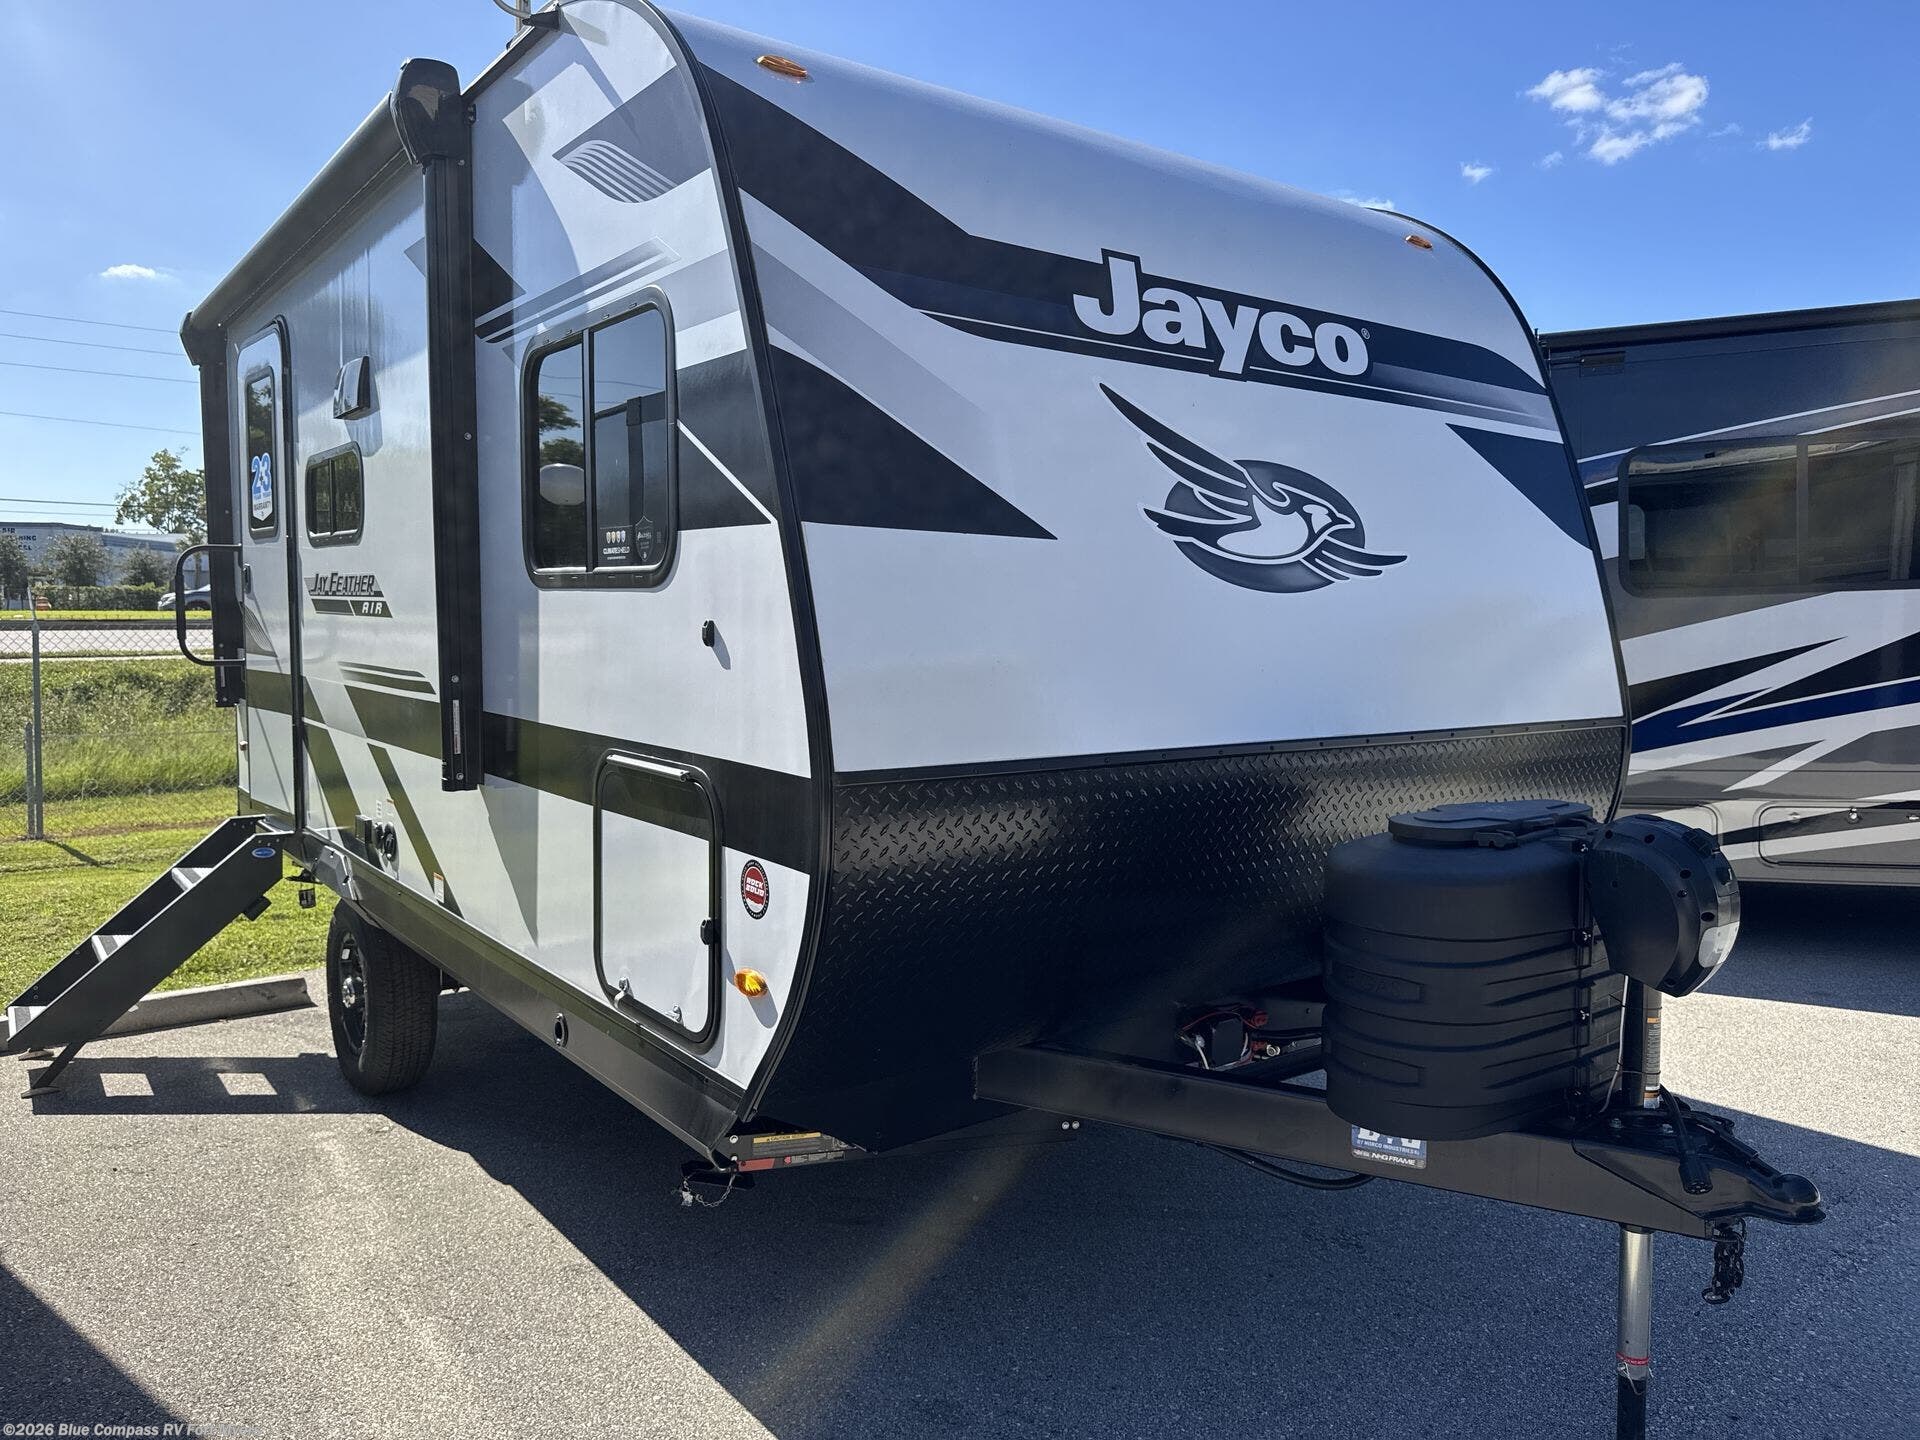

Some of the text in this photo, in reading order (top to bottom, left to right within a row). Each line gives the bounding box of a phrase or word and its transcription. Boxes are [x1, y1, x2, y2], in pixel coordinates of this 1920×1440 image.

[329, 572, 375, 593] FEATHER
[361, 601, 383, 615] AIR
[746, 876, 764, 889] ROCK
[745, 883, 765, 897] SOLID
[1388, 1155, 1416, 1166] FRAME
